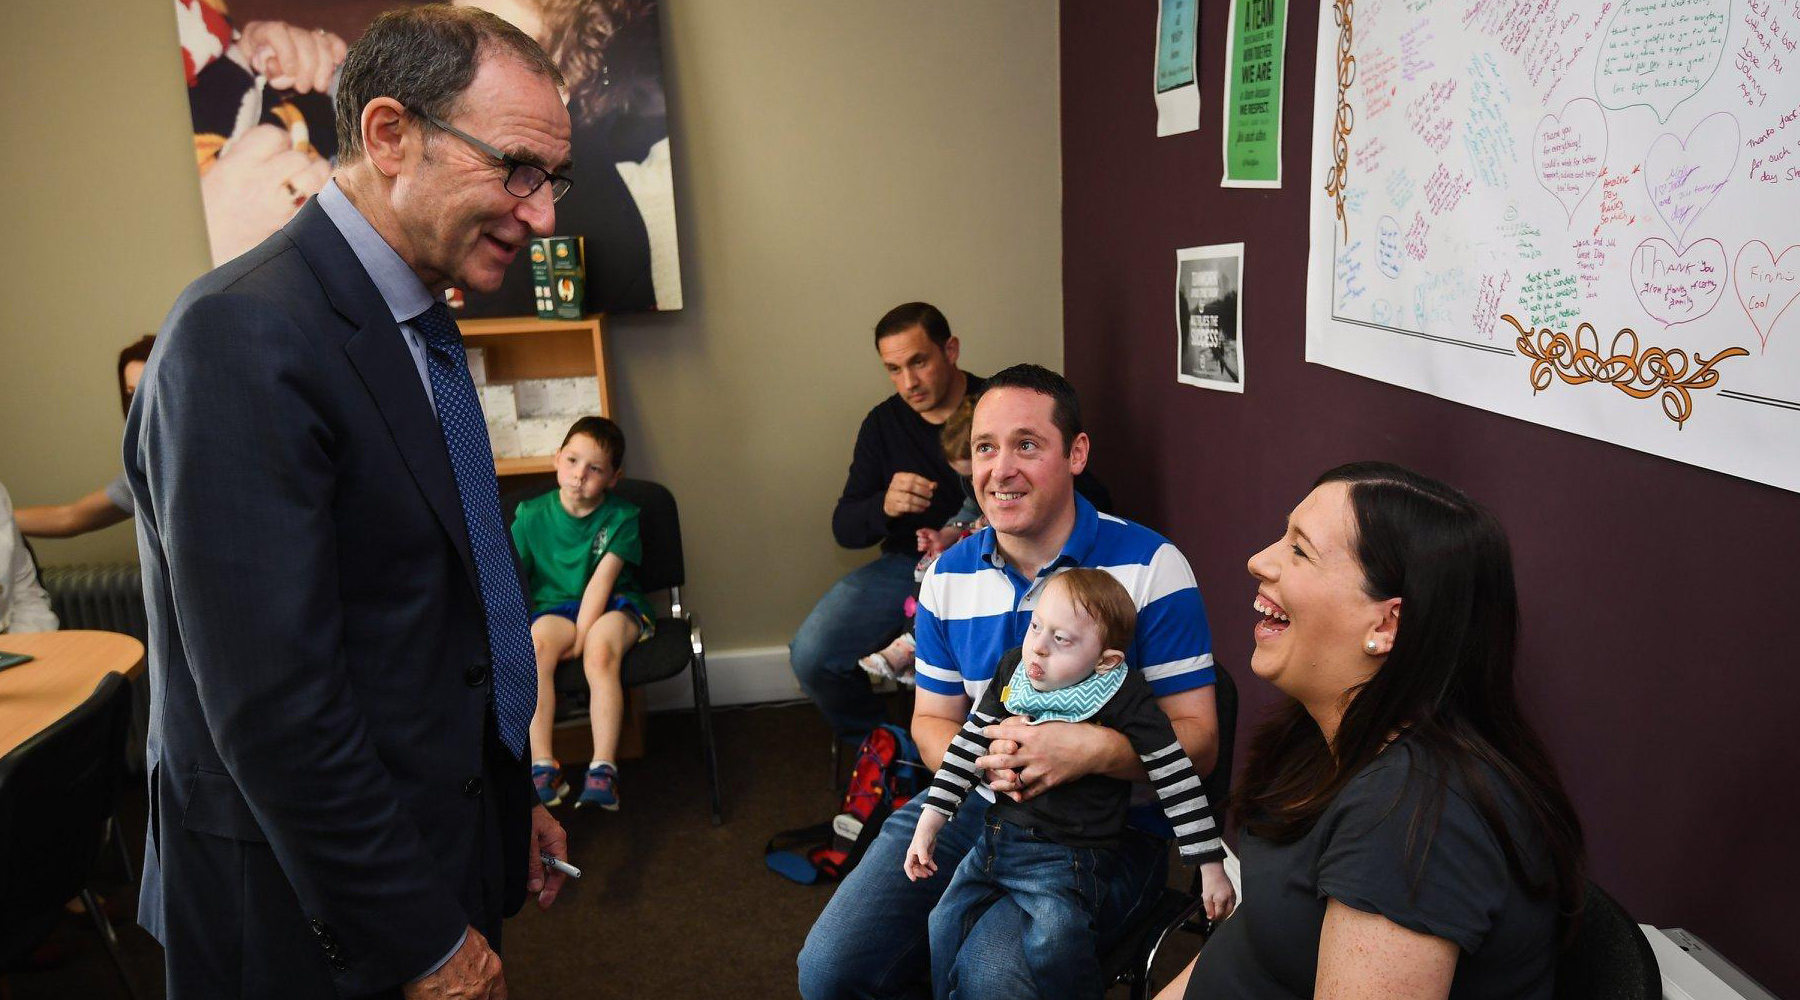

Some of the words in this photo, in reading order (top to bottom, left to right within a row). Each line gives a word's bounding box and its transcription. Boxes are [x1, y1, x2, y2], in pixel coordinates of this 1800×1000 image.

[1251, 0, 1275, 30] TEAM
[1242, 65, 1255, 85] WE
[1256, 61, 1272, 82] ARE
[1761, 171, 1778, 184] day
[1749, 294, 1770, 310] Cool
